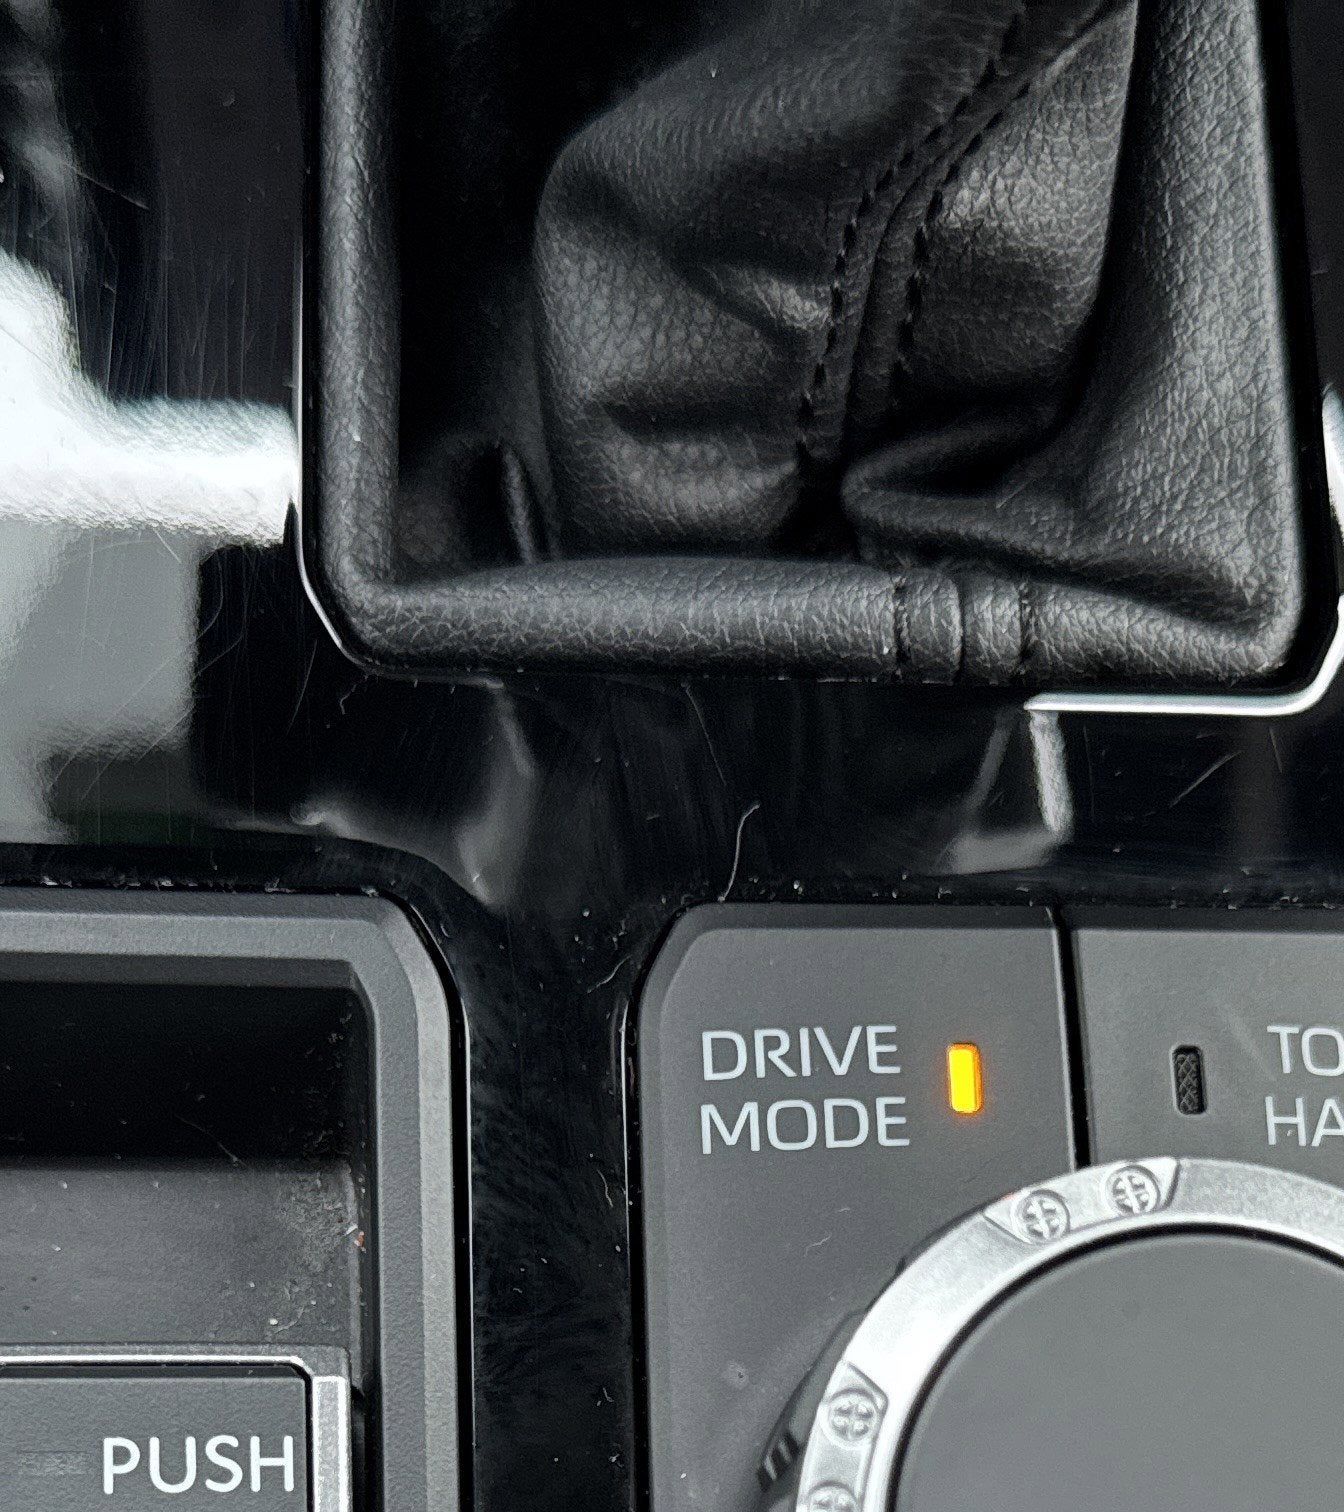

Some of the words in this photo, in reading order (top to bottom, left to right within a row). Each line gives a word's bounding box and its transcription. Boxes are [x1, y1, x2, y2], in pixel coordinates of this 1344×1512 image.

[701, 1025, 901, 1081] DRIVE
[700, 1096, 910, 1155] MODE
[102, 1434, 295, 1495] PUSH
